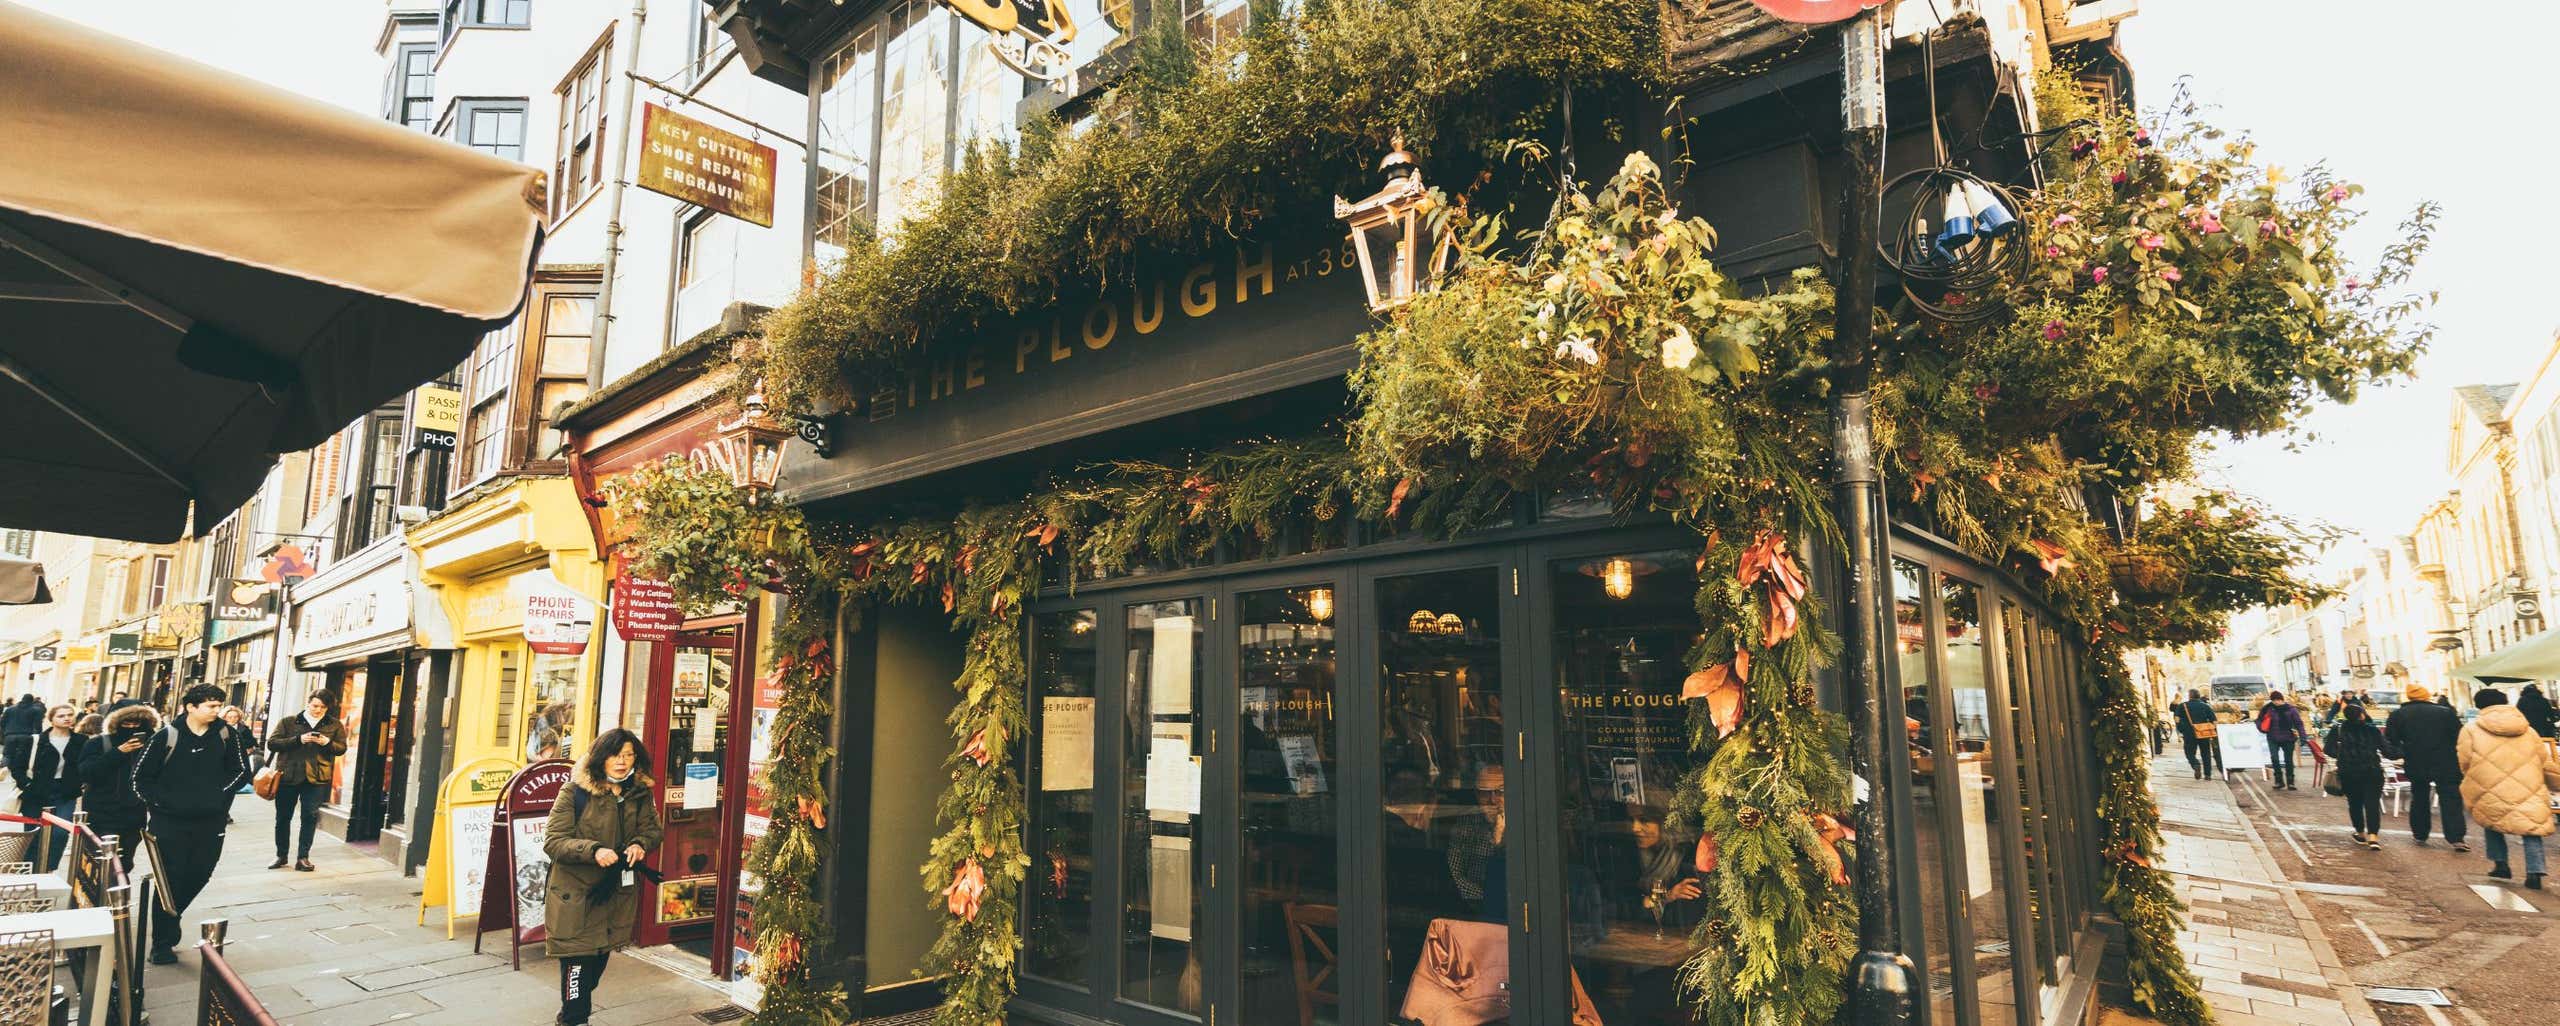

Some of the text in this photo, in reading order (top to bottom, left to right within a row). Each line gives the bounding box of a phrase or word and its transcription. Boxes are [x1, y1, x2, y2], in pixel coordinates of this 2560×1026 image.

[659, 123, 764, 169] KEY CUTTING
[651, 141, 769, 191] SHOE REPAIRS
[663, 166, 755, 206] ENGRAVING
[902, 239, 1356, 408] THE PLOUGH AT 38
[427, 409, 435, 419] &
[424, 432, 456, 447] PHO
[632, 577, 651, 586] Shoe
[631, 588, 672, 600] Key Cutting
[529, 596, 575, 609] PHONE
[630, 599, 654, 607] Watch
[220, 606, 262, 619] LEON
[528, 608, 575, 619] REPAIRS
[629, 610, 666, 620] Engraving
[628, 621, 653, 629] Phone
[1056, 703, 1089, 712] PLOUGH
[1249, 700, 1322, 711] THE PLOUGH
[1571, 695, 1688, 708] THE PLOUGH
[520, 771, 572, 797] TIMPS
